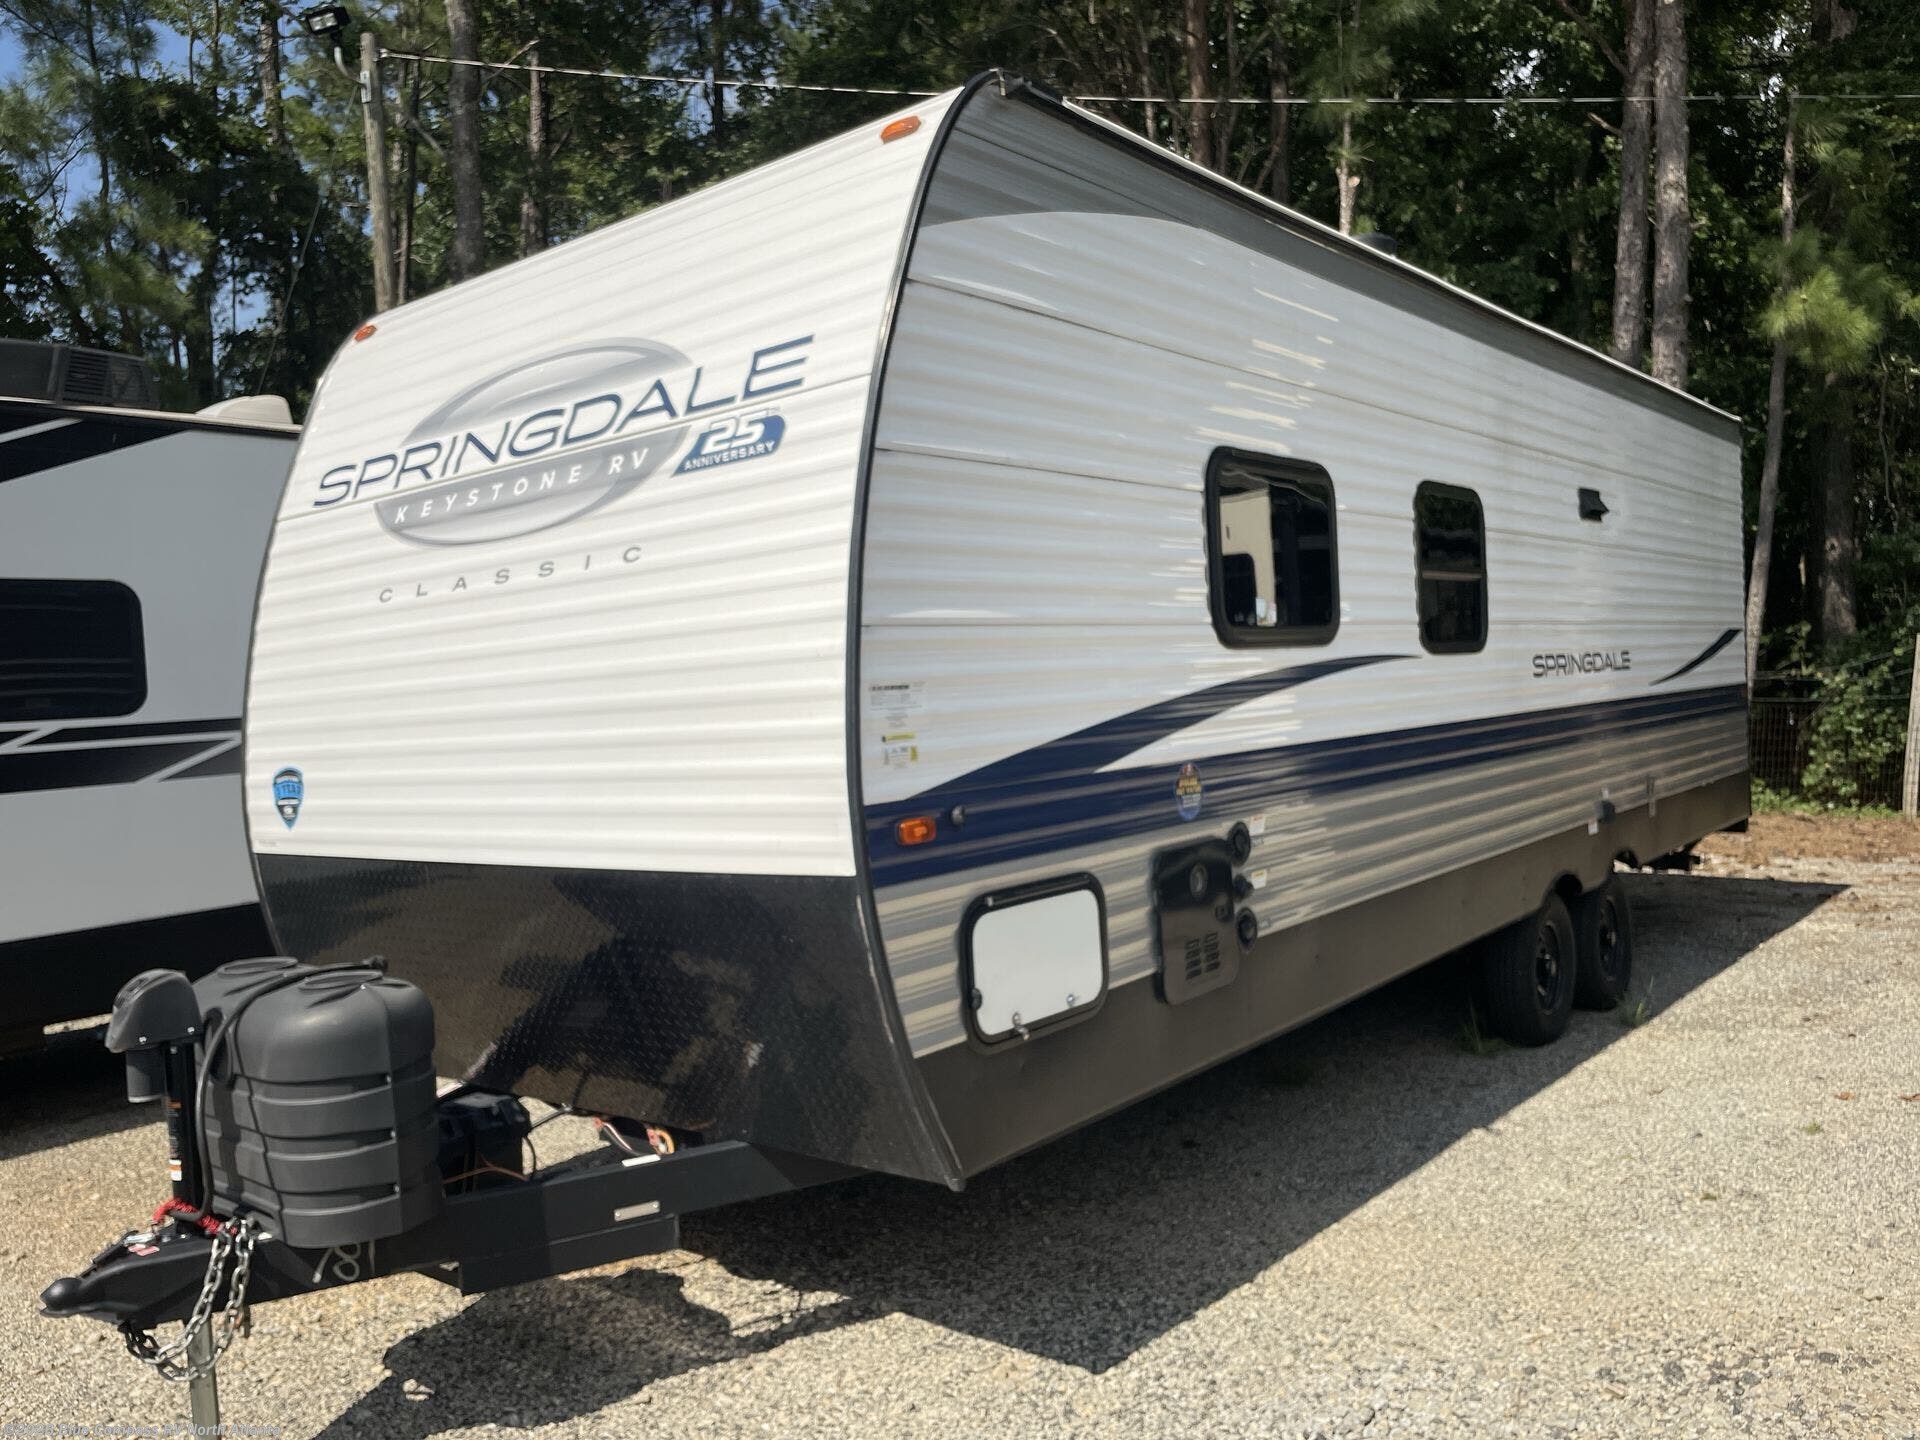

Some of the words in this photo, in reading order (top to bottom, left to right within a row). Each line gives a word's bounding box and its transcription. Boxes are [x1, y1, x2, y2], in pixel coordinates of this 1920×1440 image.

[313, 334, 815, 507] SPRINGDALE
[701, 409, 768, 455] 25
[684, 441, 775, 470] ANNIVERSARY
[394, 463, 583, 525] KEYSTONE
[608, 448, 650, 475] RV
[378, 545, 643, 604] CLASSIC
[1532, 650, 1632, 678] SPRINGDALE
